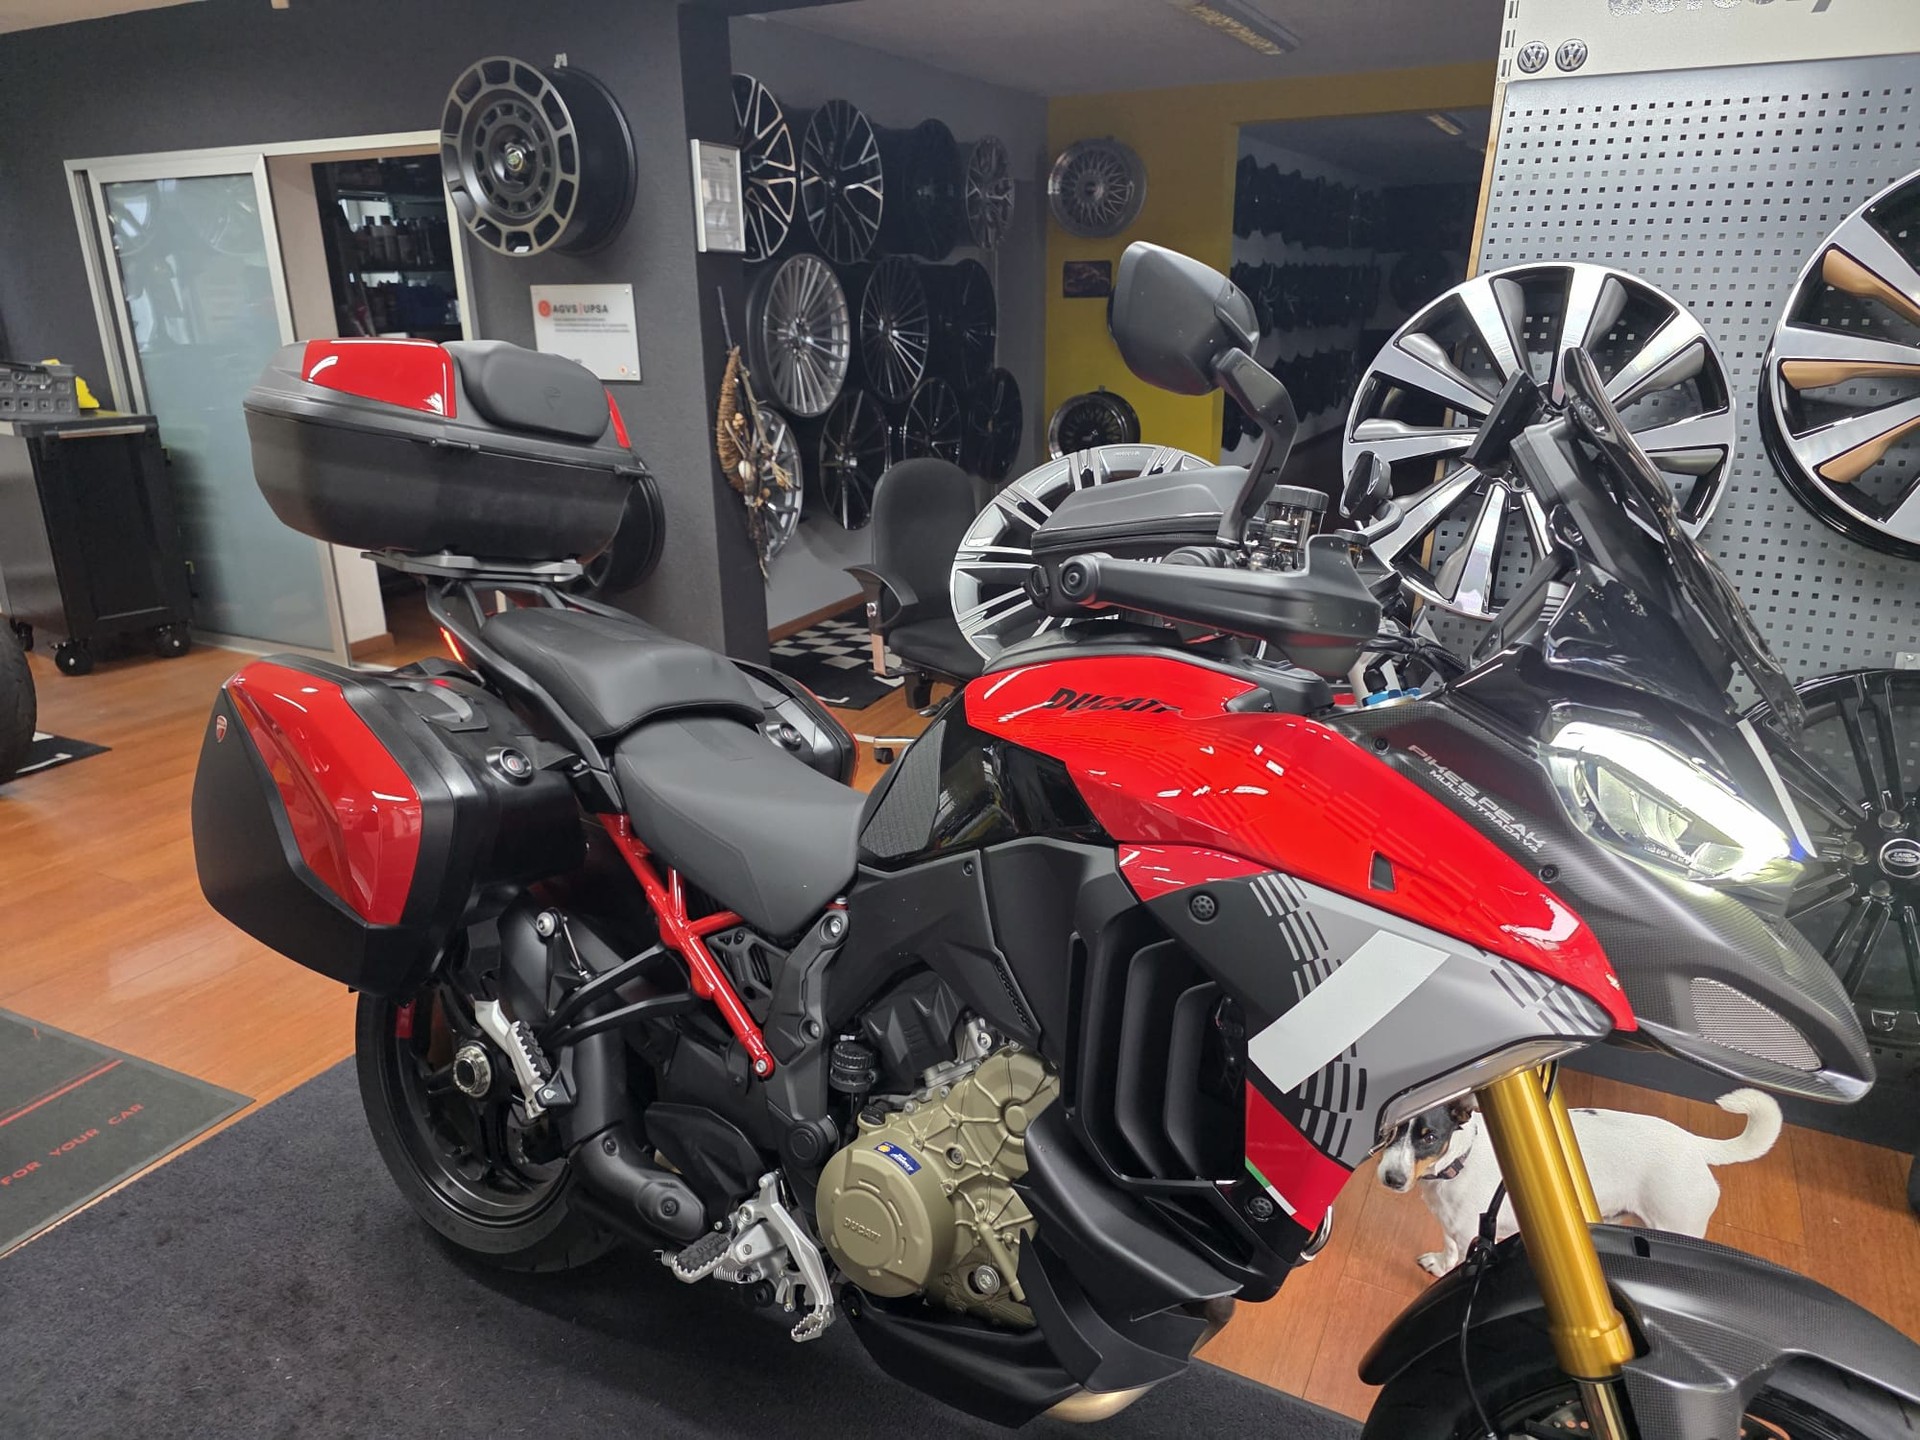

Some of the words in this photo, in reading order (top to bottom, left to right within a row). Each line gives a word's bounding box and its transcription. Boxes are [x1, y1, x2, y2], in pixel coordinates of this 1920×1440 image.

[583, 304, 608, 314] UPSA
[1042, 687, 1181, 714] DUCATI
[1408, 745, 1479, 798] PIKES
[1478, 796, 1546, 848] PEAK
[1430, 770, 1520, 841] MULTISTRADA
[0, 1161, 41, 1185] FOR
[48, 1128, 99, 1156] YOUR
[107, 1103, 144, 1125] CAR
[844, 1216, 881, 1243] DUCATI
